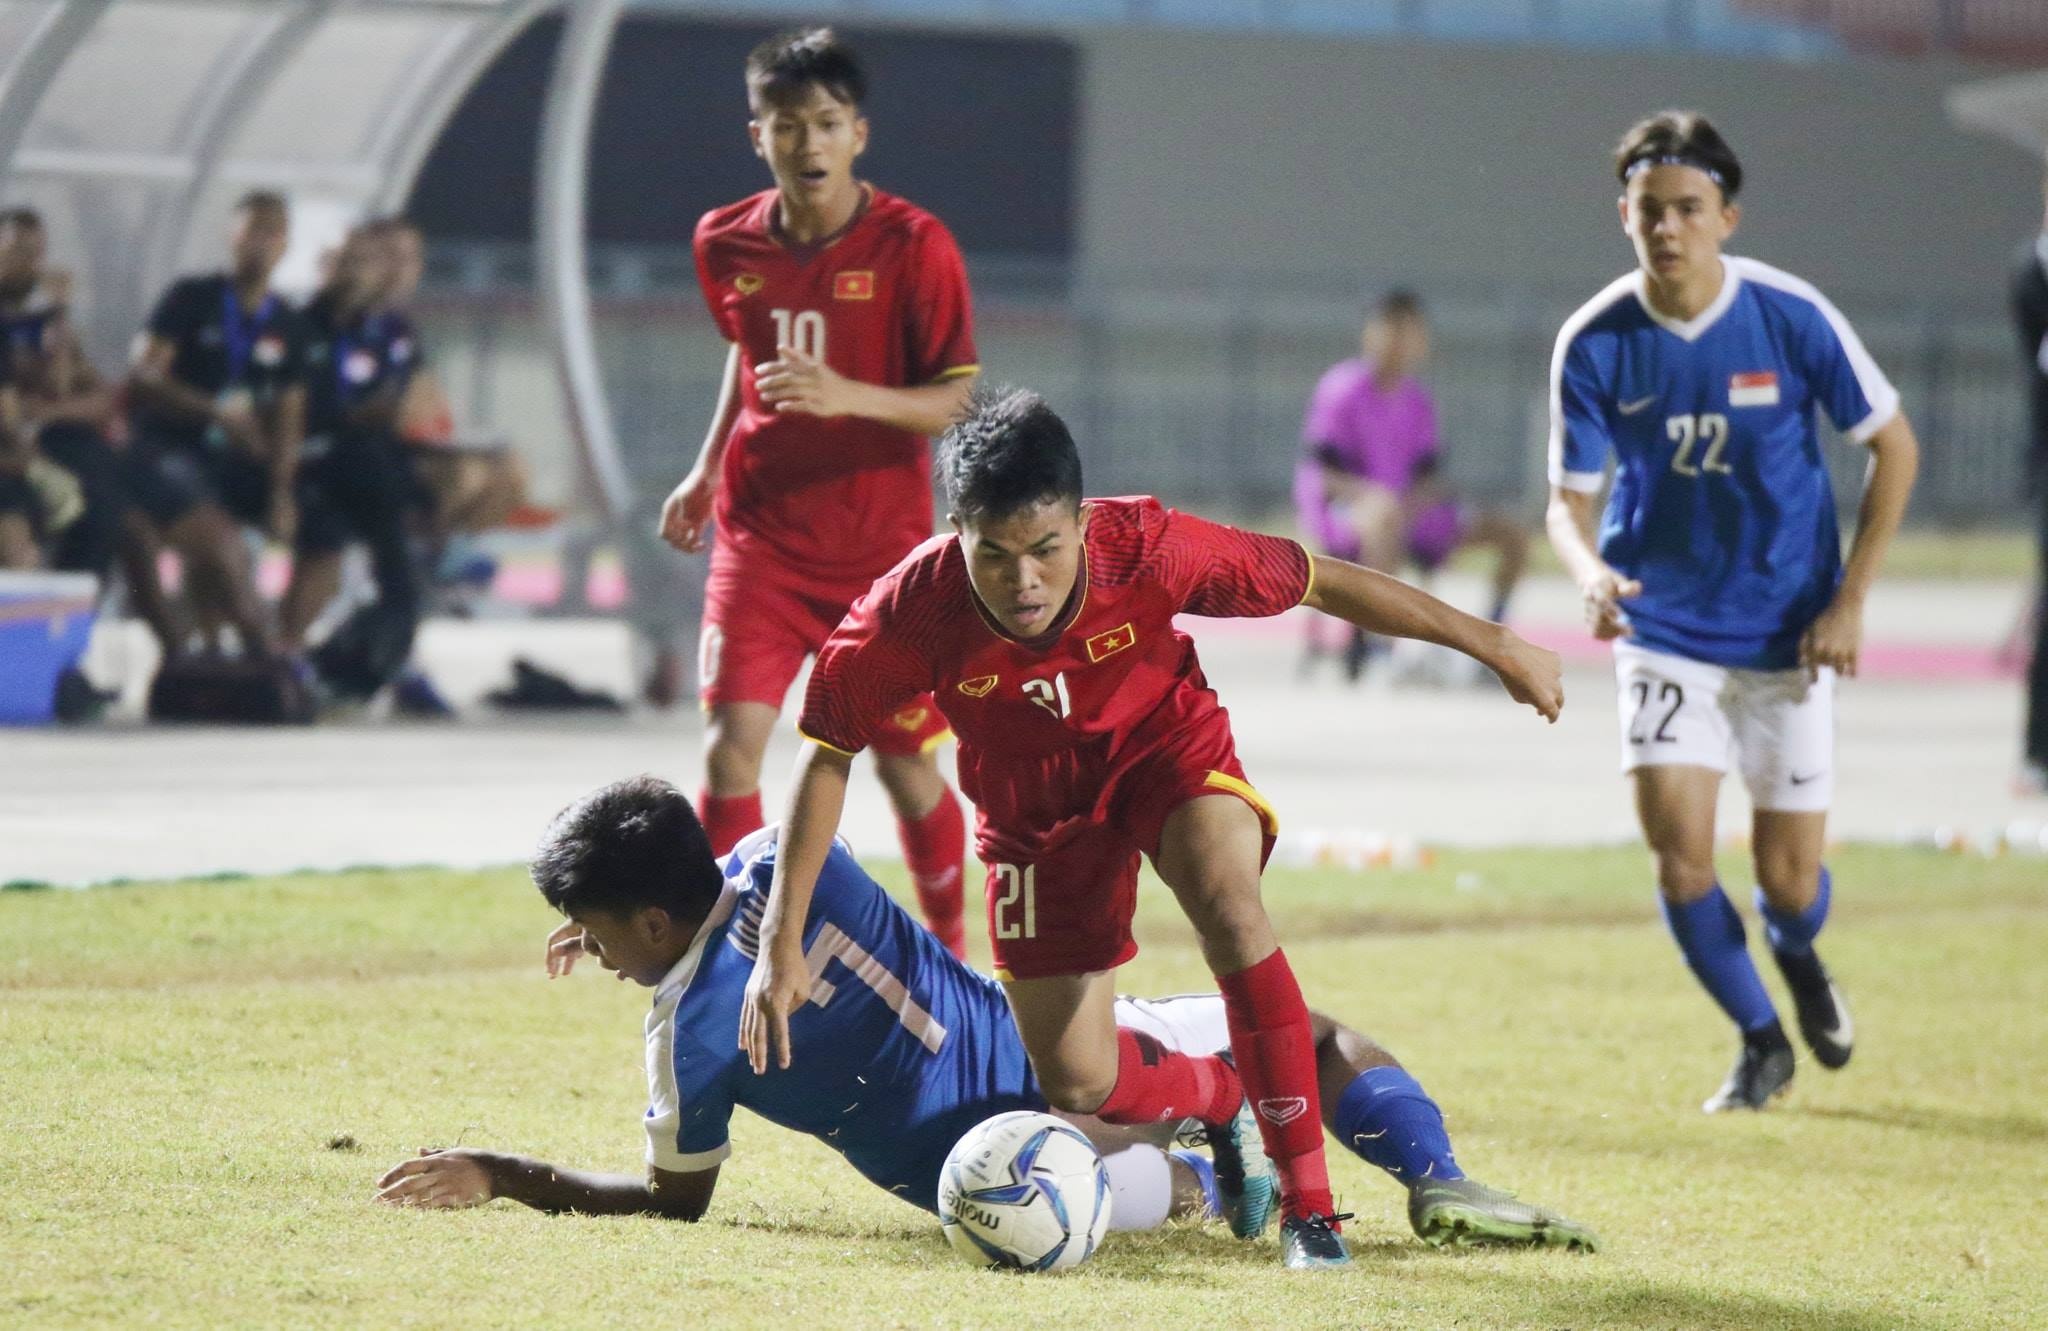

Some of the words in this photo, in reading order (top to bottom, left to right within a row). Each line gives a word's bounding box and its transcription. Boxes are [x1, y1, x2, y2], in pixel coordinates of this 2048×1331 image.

[770, 309, 828, 364] 10
[1665, 413, 1731, 476] 22
[1022, 671, 1071, 719] 21
[1629, 682, 1684, 746] 22
[995, 863, 1037, 939] 21
